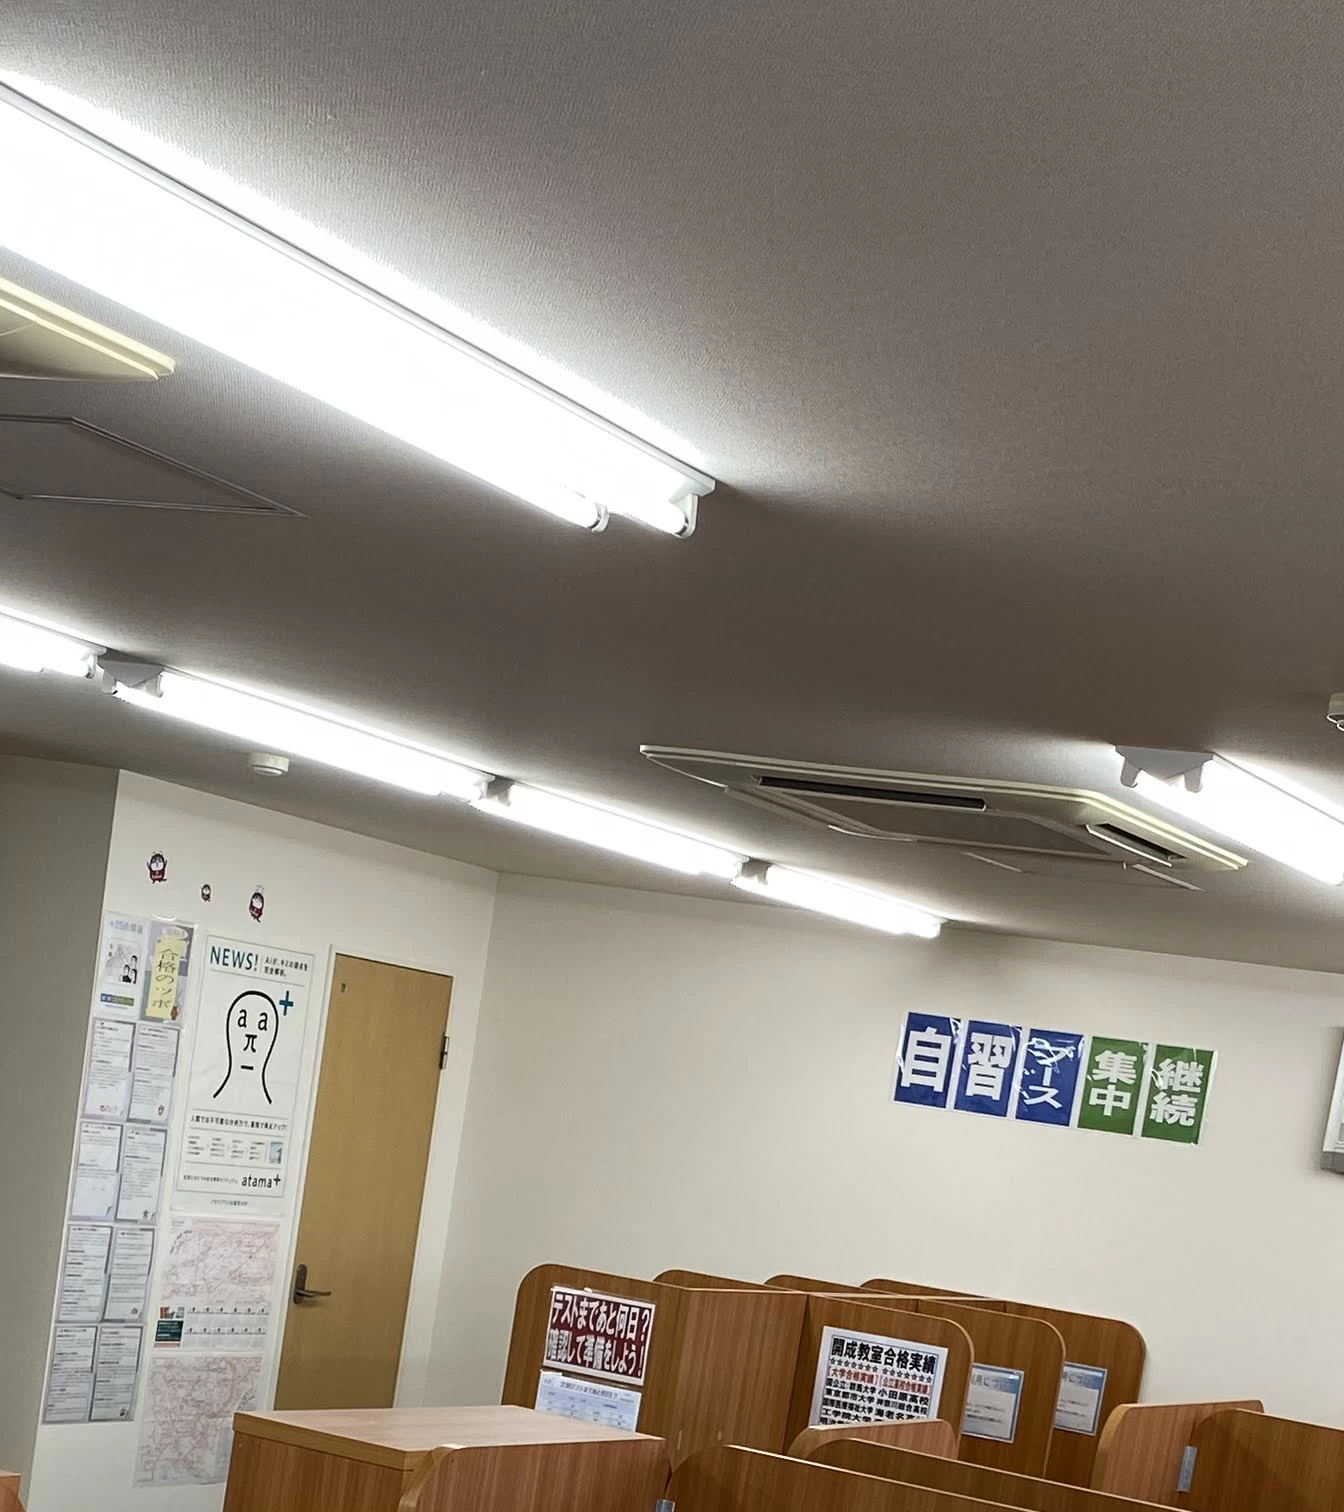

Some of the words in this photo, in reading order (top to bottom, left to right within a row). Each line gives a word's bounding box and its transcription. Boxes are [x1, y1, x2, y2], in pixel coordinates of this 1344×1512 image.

[210, 945, 259, 972] NEWS!
[1087, 1048, 1138, 1119] 集中
[1148, 1058, 1202, 1127] 継続
[831, 1337, 937, 1375] 開成教室合格実績
